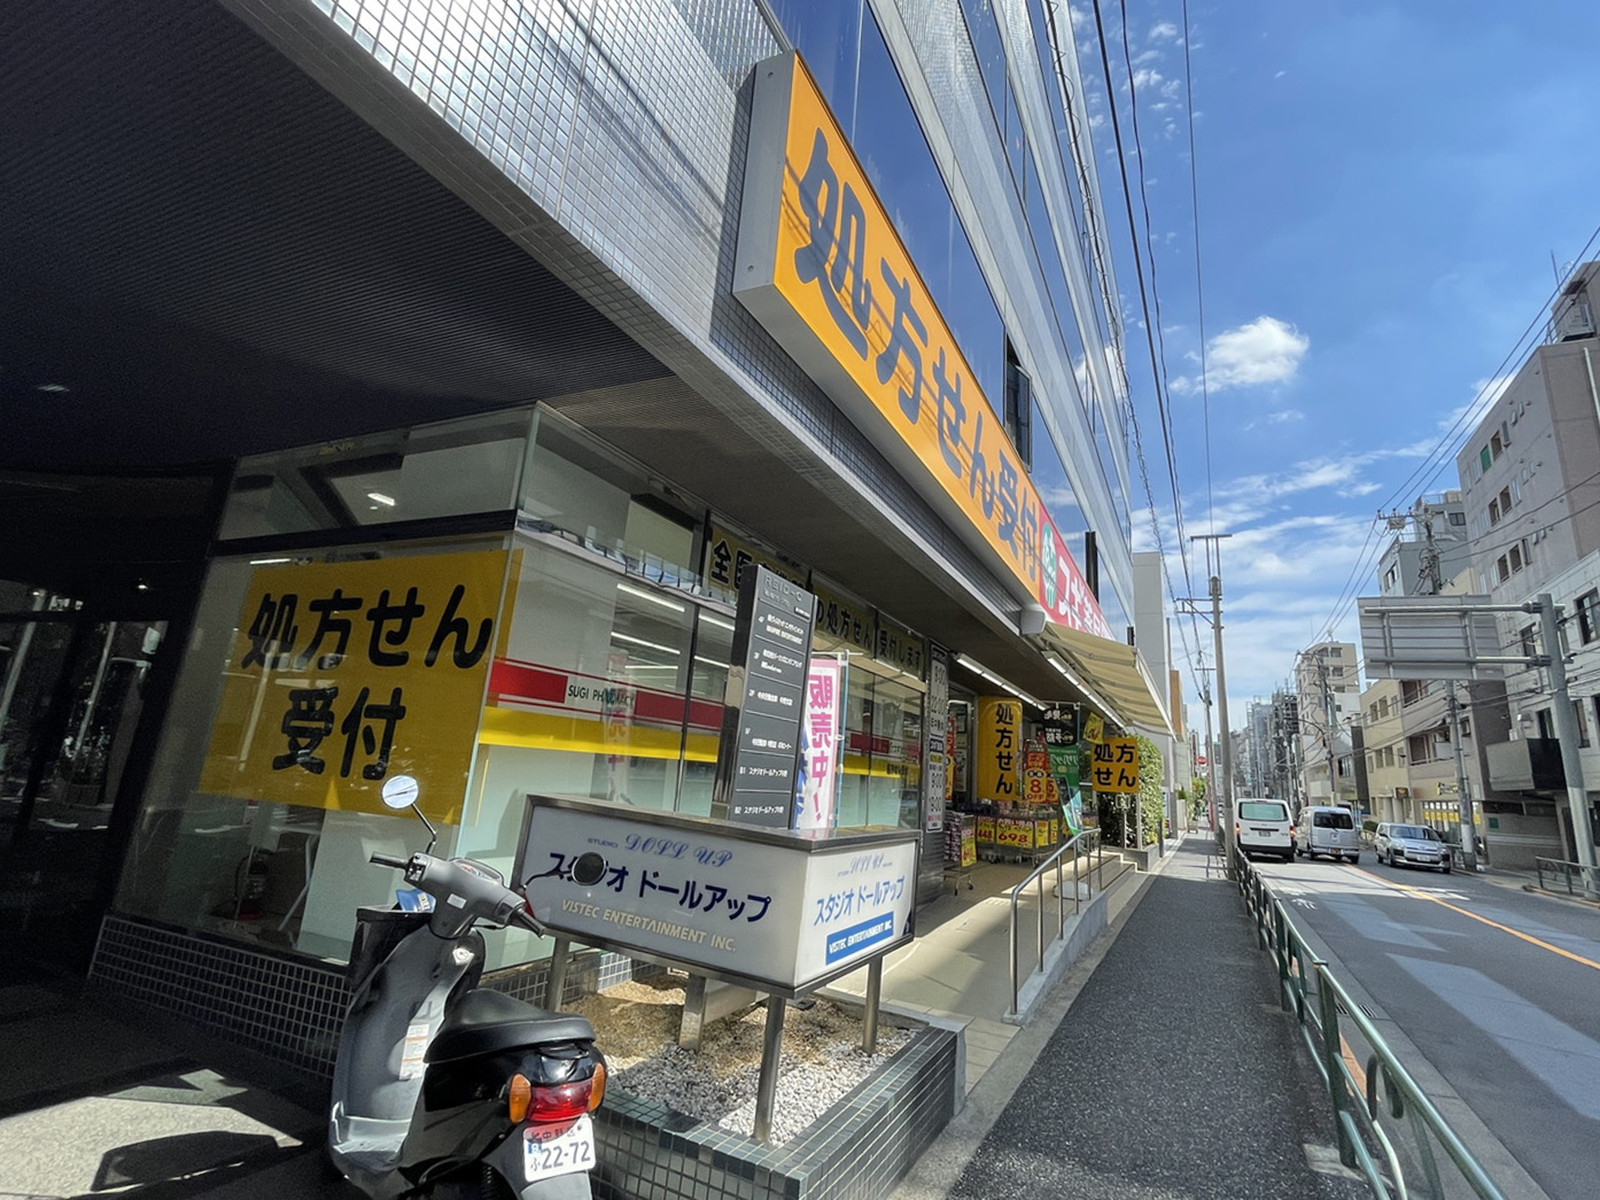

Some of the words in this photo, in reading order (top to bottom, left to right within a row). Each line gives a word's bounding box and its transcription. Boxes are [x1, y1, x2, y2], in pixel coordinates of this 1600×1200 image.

[794, 126, 1039, 582] 処方せん受付
[241, 584, 493, 670] 処方せん
[568, 684, 590, 699] SUGI
[272, 686, 407, 780] 受付
[995, 703, 1013, 794] 処方せん
[1093, 743, 1136, 764] 処方
[1093, 767, 1136, 787] せん
[587, 838, 618, 848] STUDIO
[625, 833, 689, 861] DOLL
[693, 847, 733, 867] UP
[549, 852, 629, 892] スオ
[639, 869, 772, 922] ドールアップ
[814, 888, 855, 926] スタジオ
[857, 875, 905, 913] ドールアップ
[561, 899, 600, 919] VISTEC
[602, 908, 707, 945] ENTERTAINMENT
[710, 934, 736, 952] INC.
[541, 1140, 592, 1170] 22-72
